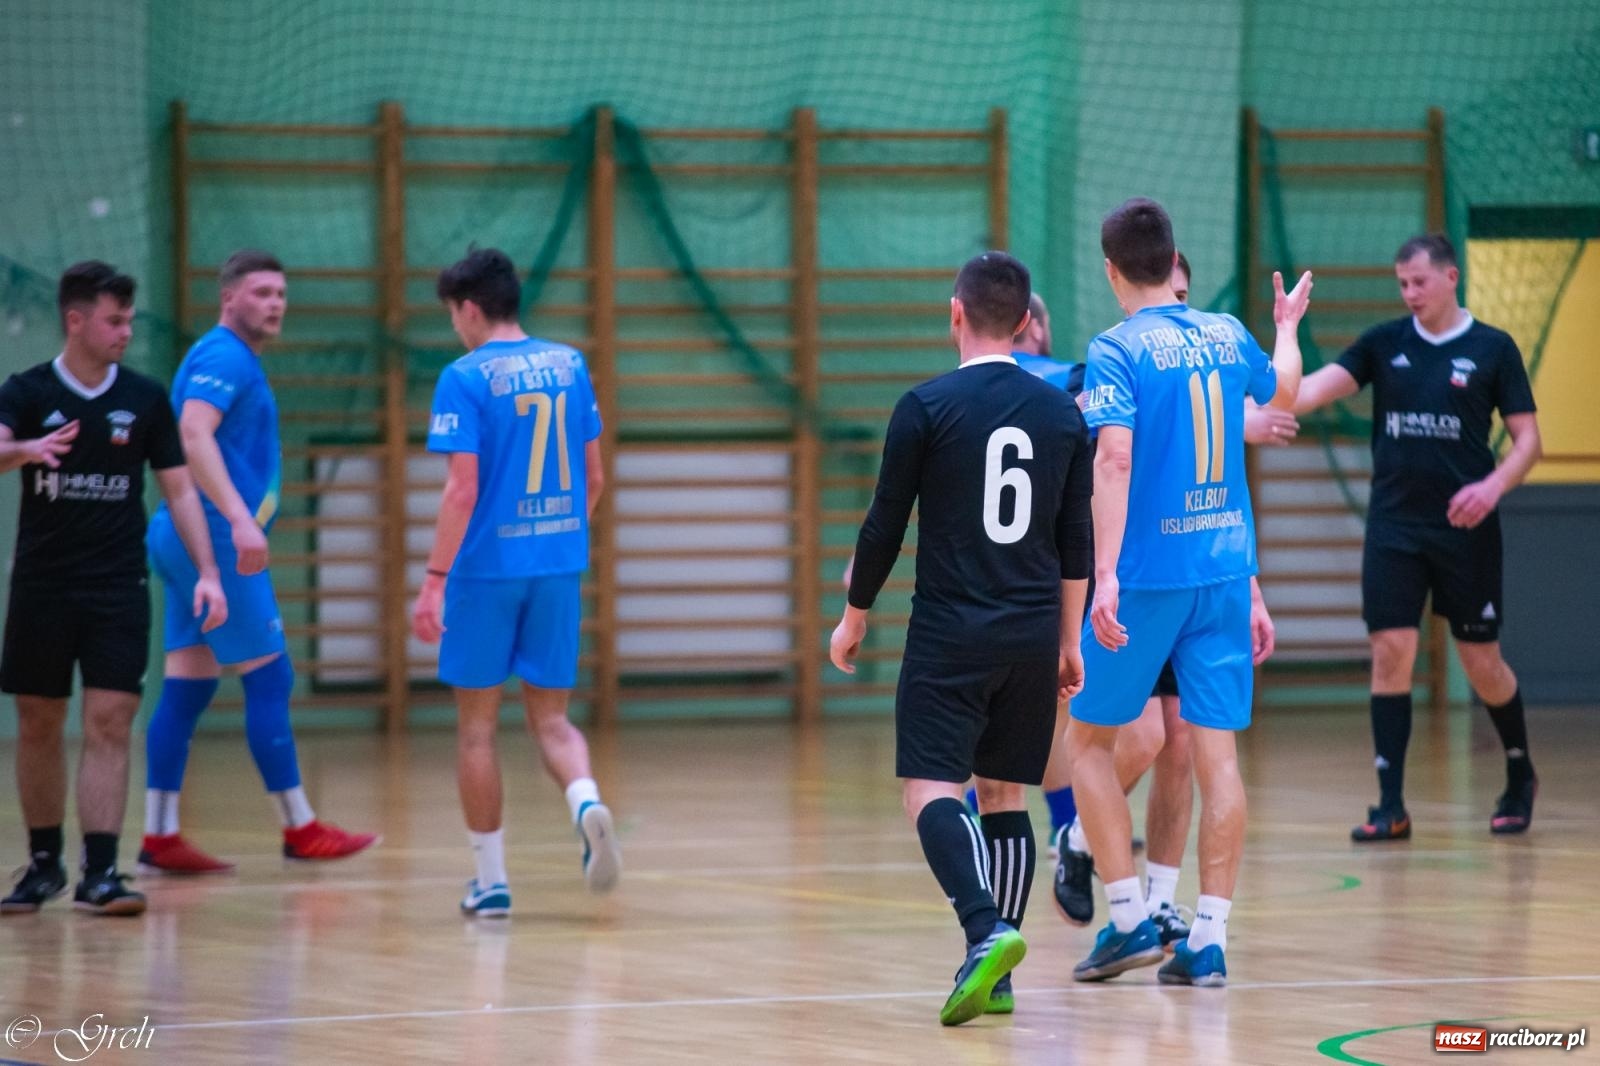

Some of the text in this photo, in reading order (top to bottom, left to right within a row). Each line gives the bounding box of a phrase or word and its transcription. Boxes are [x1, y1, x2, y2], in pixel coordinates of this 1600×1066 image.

[1139, 327, 1188, 352] FIRMA
[1152, 346, 1181, 371] 607
[1182, 345, 1214, 369] 931
[514, 391, 572, 494] 71
[1188, 368, 1224, 485] 11
[983, 426, 1034, 544] 6
